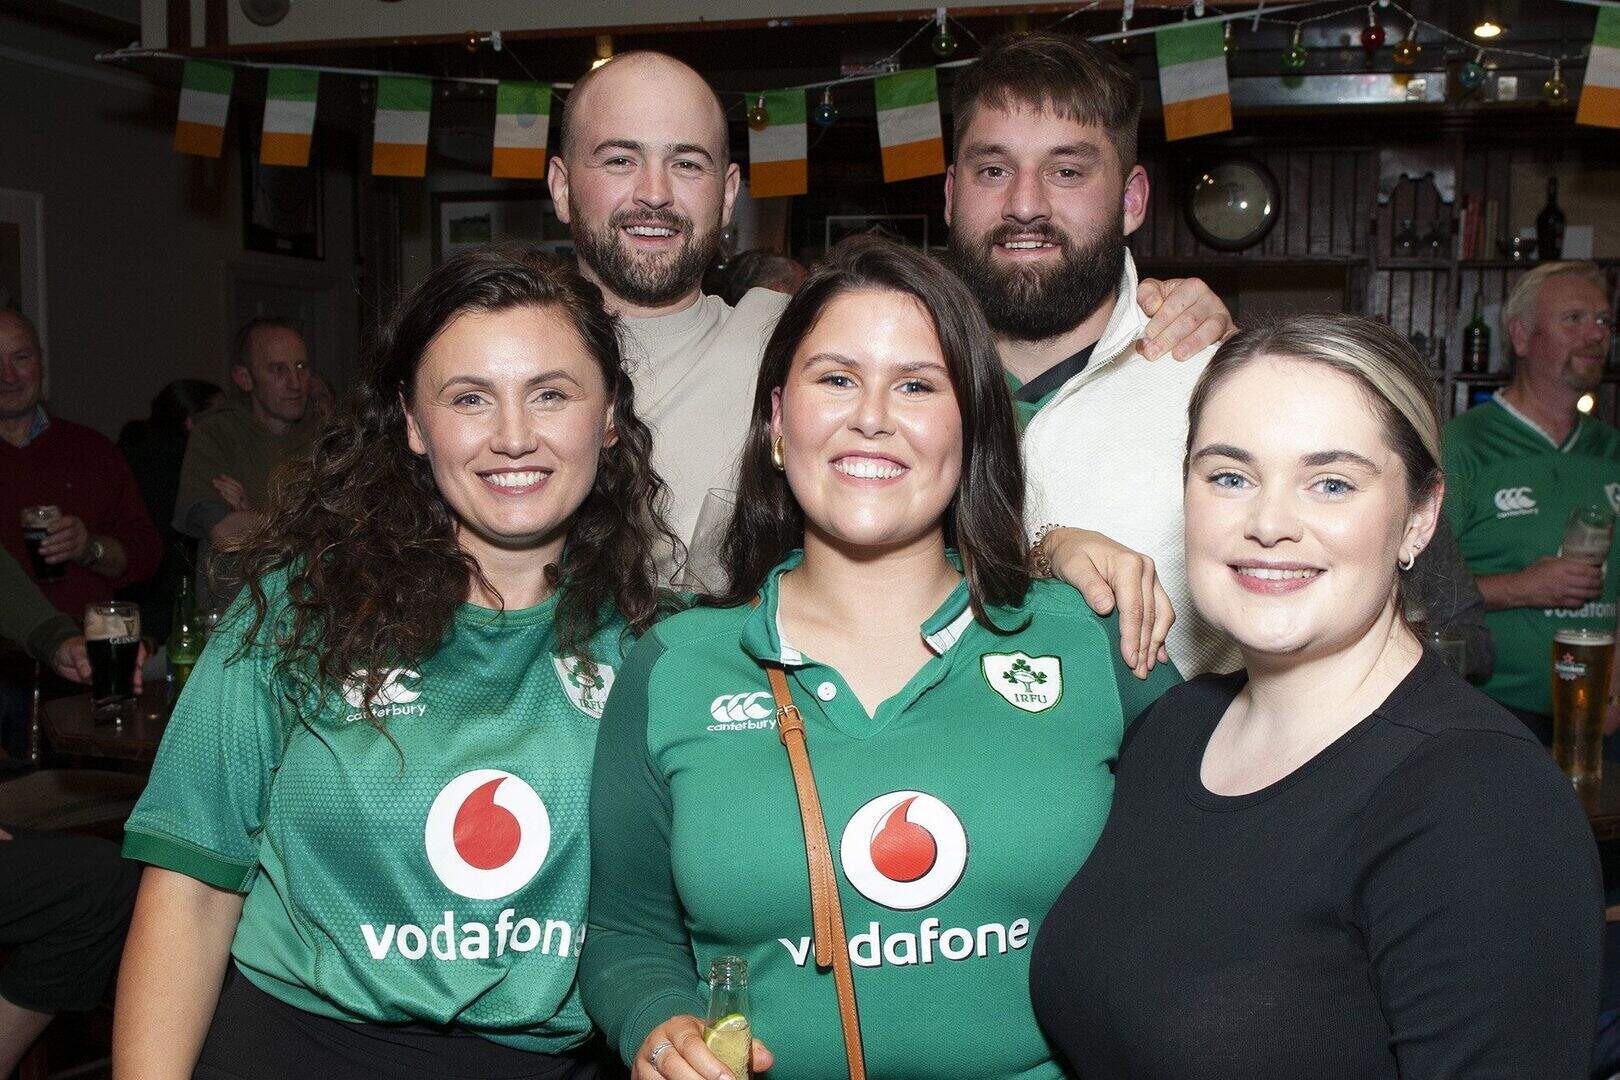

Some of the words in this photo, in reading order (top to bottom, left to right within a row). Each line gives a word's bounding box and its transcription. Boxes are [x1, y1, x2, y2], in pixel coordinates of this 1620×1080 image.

[1014, 693, 1048, 703] IRFU
[706, 719, 777, 731] canterbury
[777, 917, 1030, 967] vdafone
